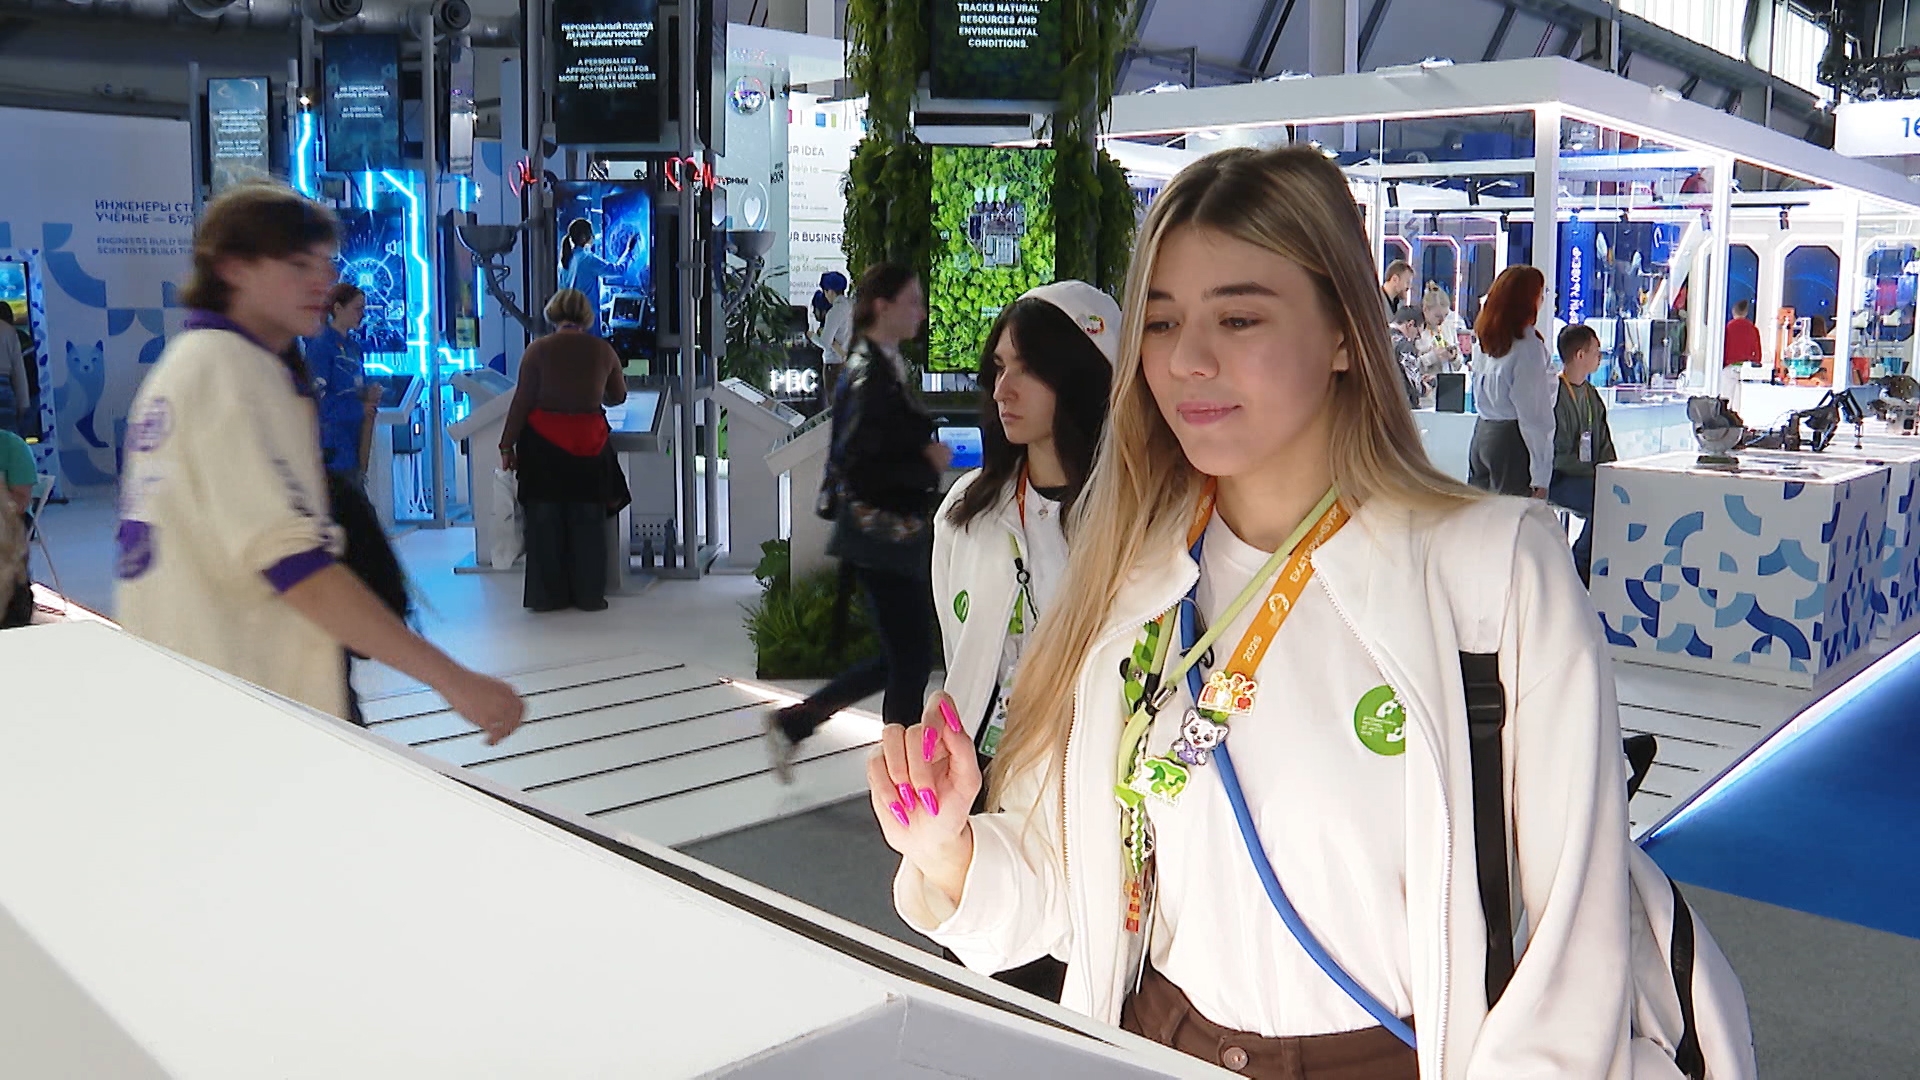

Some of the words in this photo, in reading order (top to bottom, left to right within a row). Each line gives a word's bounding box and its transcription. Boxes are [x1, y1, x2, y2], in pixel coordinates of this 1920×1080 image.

[957, 3, 995, 12] TRACKS
[996, 3, 1040, 13] NATURAL
[960, 14, 1015, 24] RESOURCES
[1017, 15, 1038, 25] AND
[561, 22, 621, 32] ПЕРСОНАЛЬНЫЙ
[622, 22, 654, 31] ПОДХОД
[958, 26, 1039, 36] ENVIRONMENTAL
[595, 30, 649, 39] ДИАГНОСТИКУ
[968, 38, 1029, 48] CONDITIONS.
[801, 145, 825, 157] IDEA
[95, 200, 171, 212] ИНЖЕНЕРЫ
[168, 213, 192, 225] БУД
[802, 232, 842, 244] BUSINES
